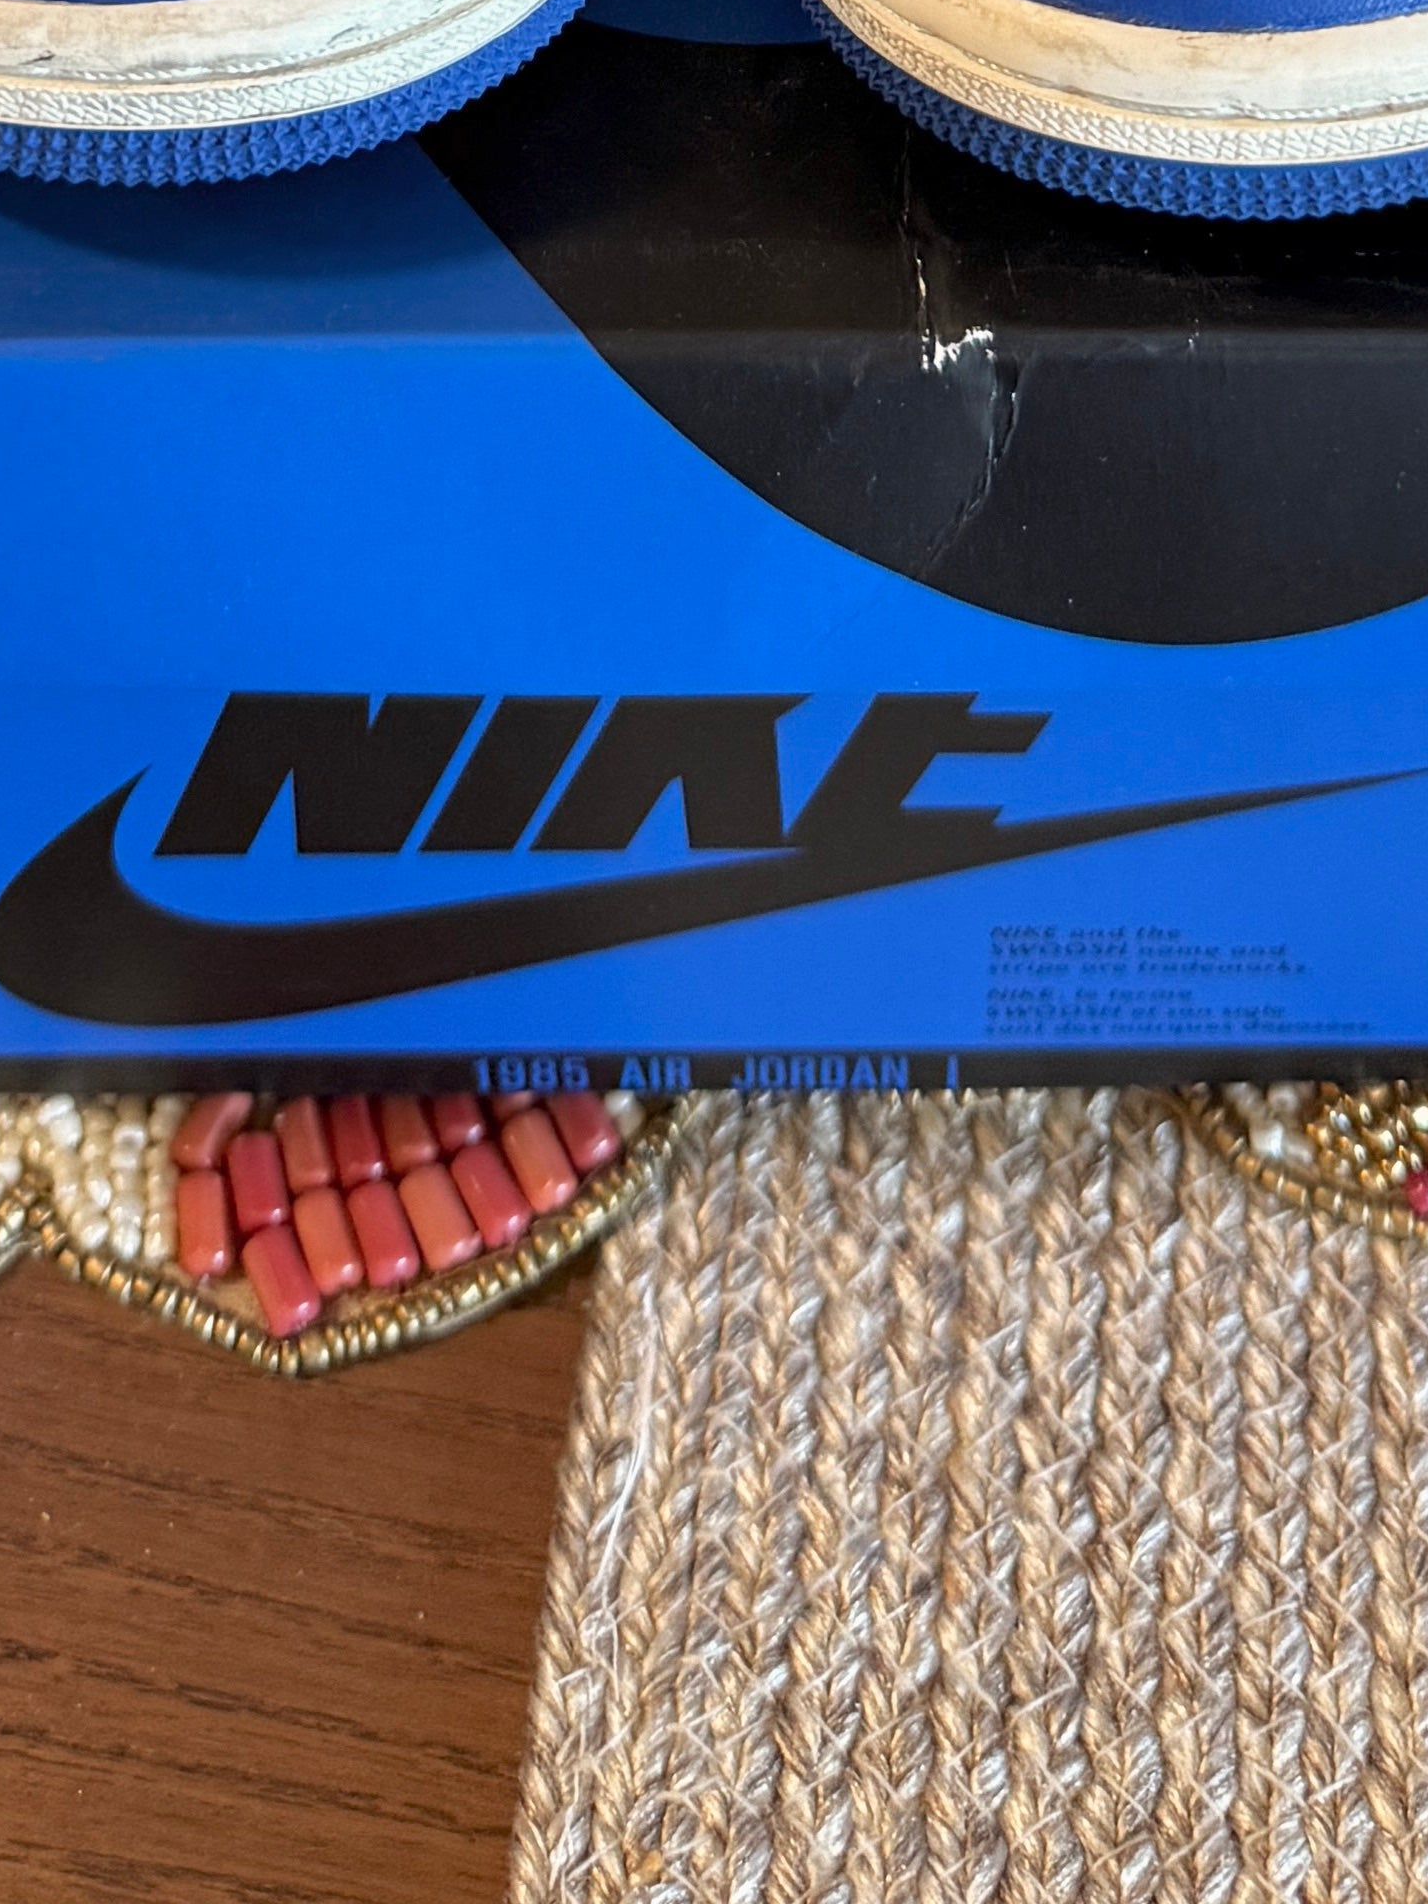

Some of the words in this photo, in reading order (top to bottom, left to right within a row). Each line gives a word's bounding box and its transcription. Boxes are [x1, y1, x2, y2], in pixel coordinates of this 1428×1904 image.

[154, 690, 1054, 856] NIKE
[473, 1055, 590, 1094] 1985
[619, 1054, 692, 1093] AIR
[731, 1054, 908, 1092] JORDAN
